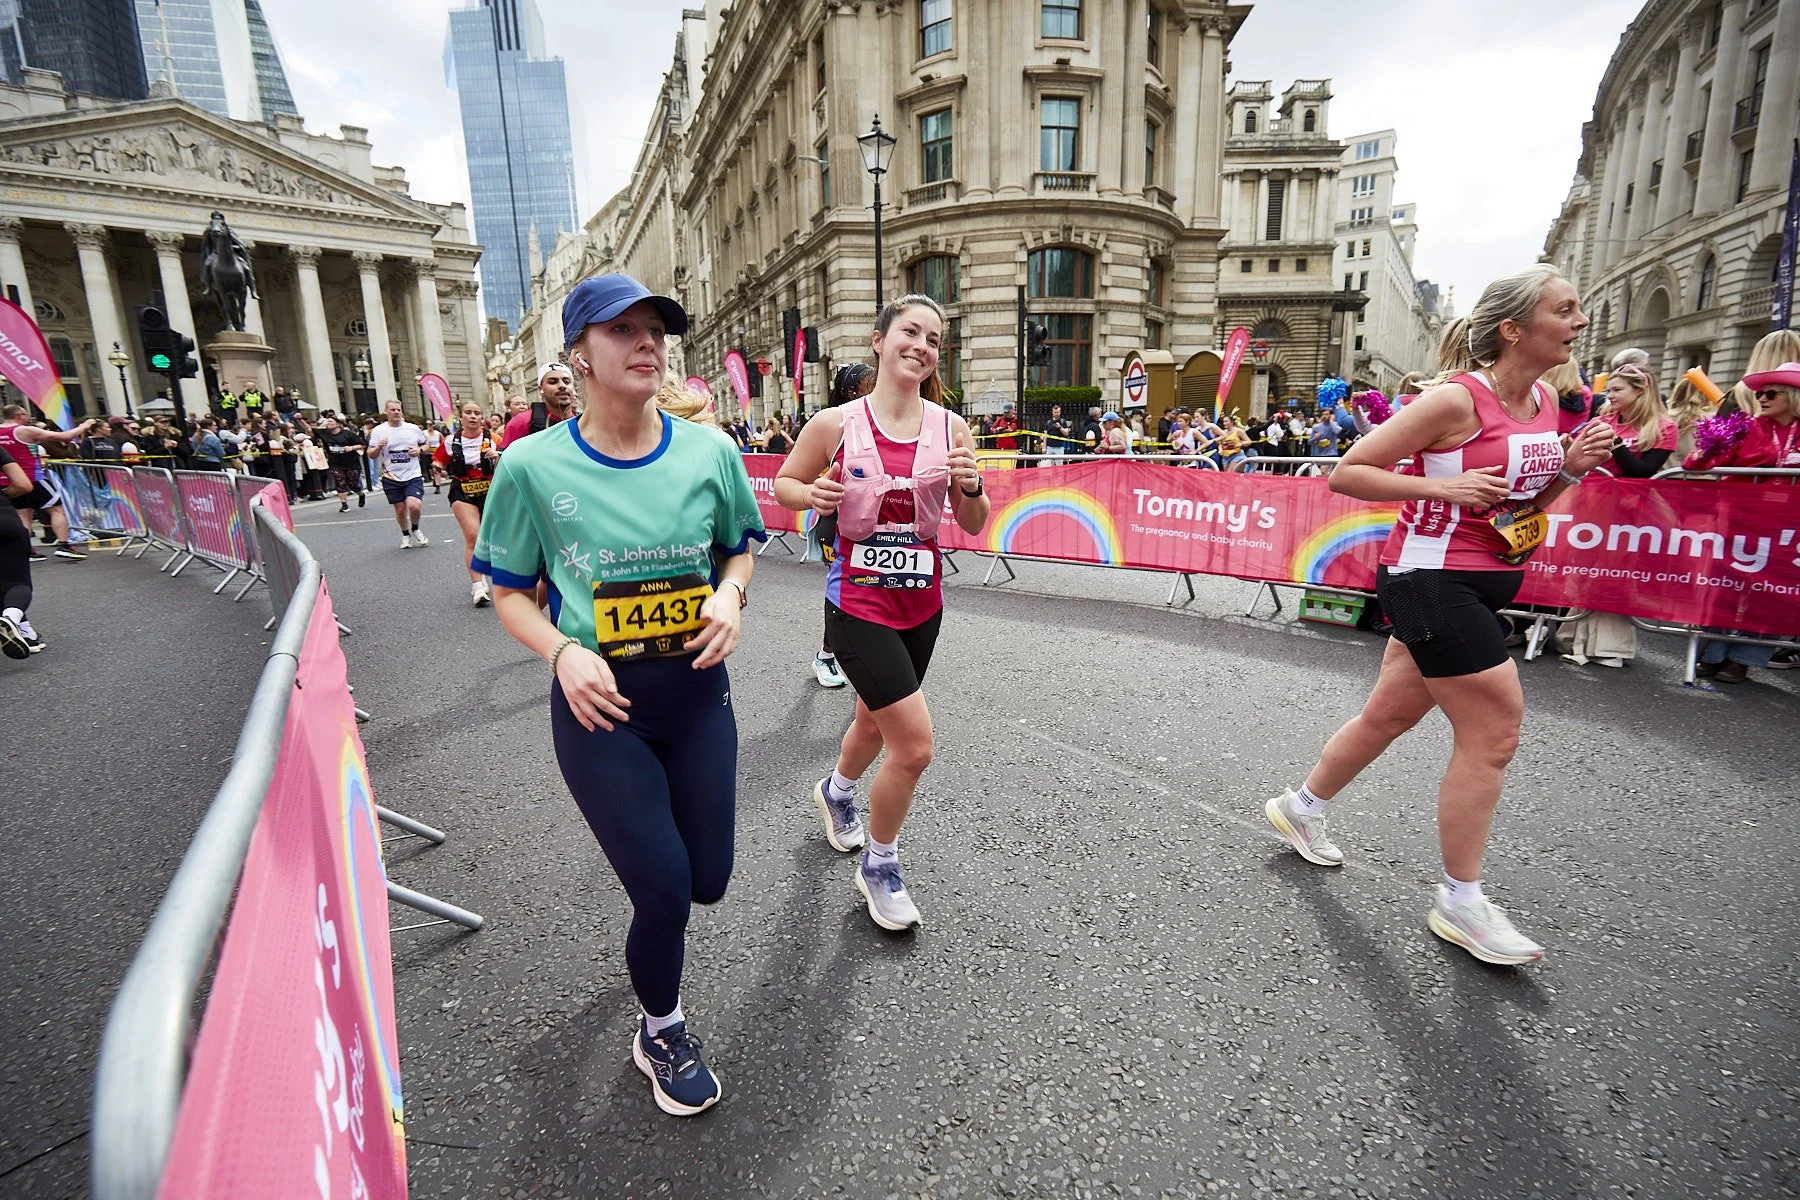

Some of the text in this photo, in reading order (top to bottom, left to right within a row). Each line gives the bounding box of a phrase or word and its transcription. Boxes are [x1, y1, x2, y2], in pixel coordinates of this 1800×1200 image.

[1520, 457, 1562, 475] CANCER
[1133, 488, 1277, 533] Tommy's
[876, 534, 913, 544] EMILY HILL
[1130, 524, 1273, 551] The pregnancy and baby charity
[599, 548, 616, 564] St
[619, 545, 668, 563] John's
[863, 547, 919, 571] 9201
[601, 569, 610, 578] St
[611, 567, 632, 577] John
[1529, 561, 1800, 595] The pregnancy and baby chari
[640, 580, 672, 593] ANNA
[605, 594, 707, 632] 14437
